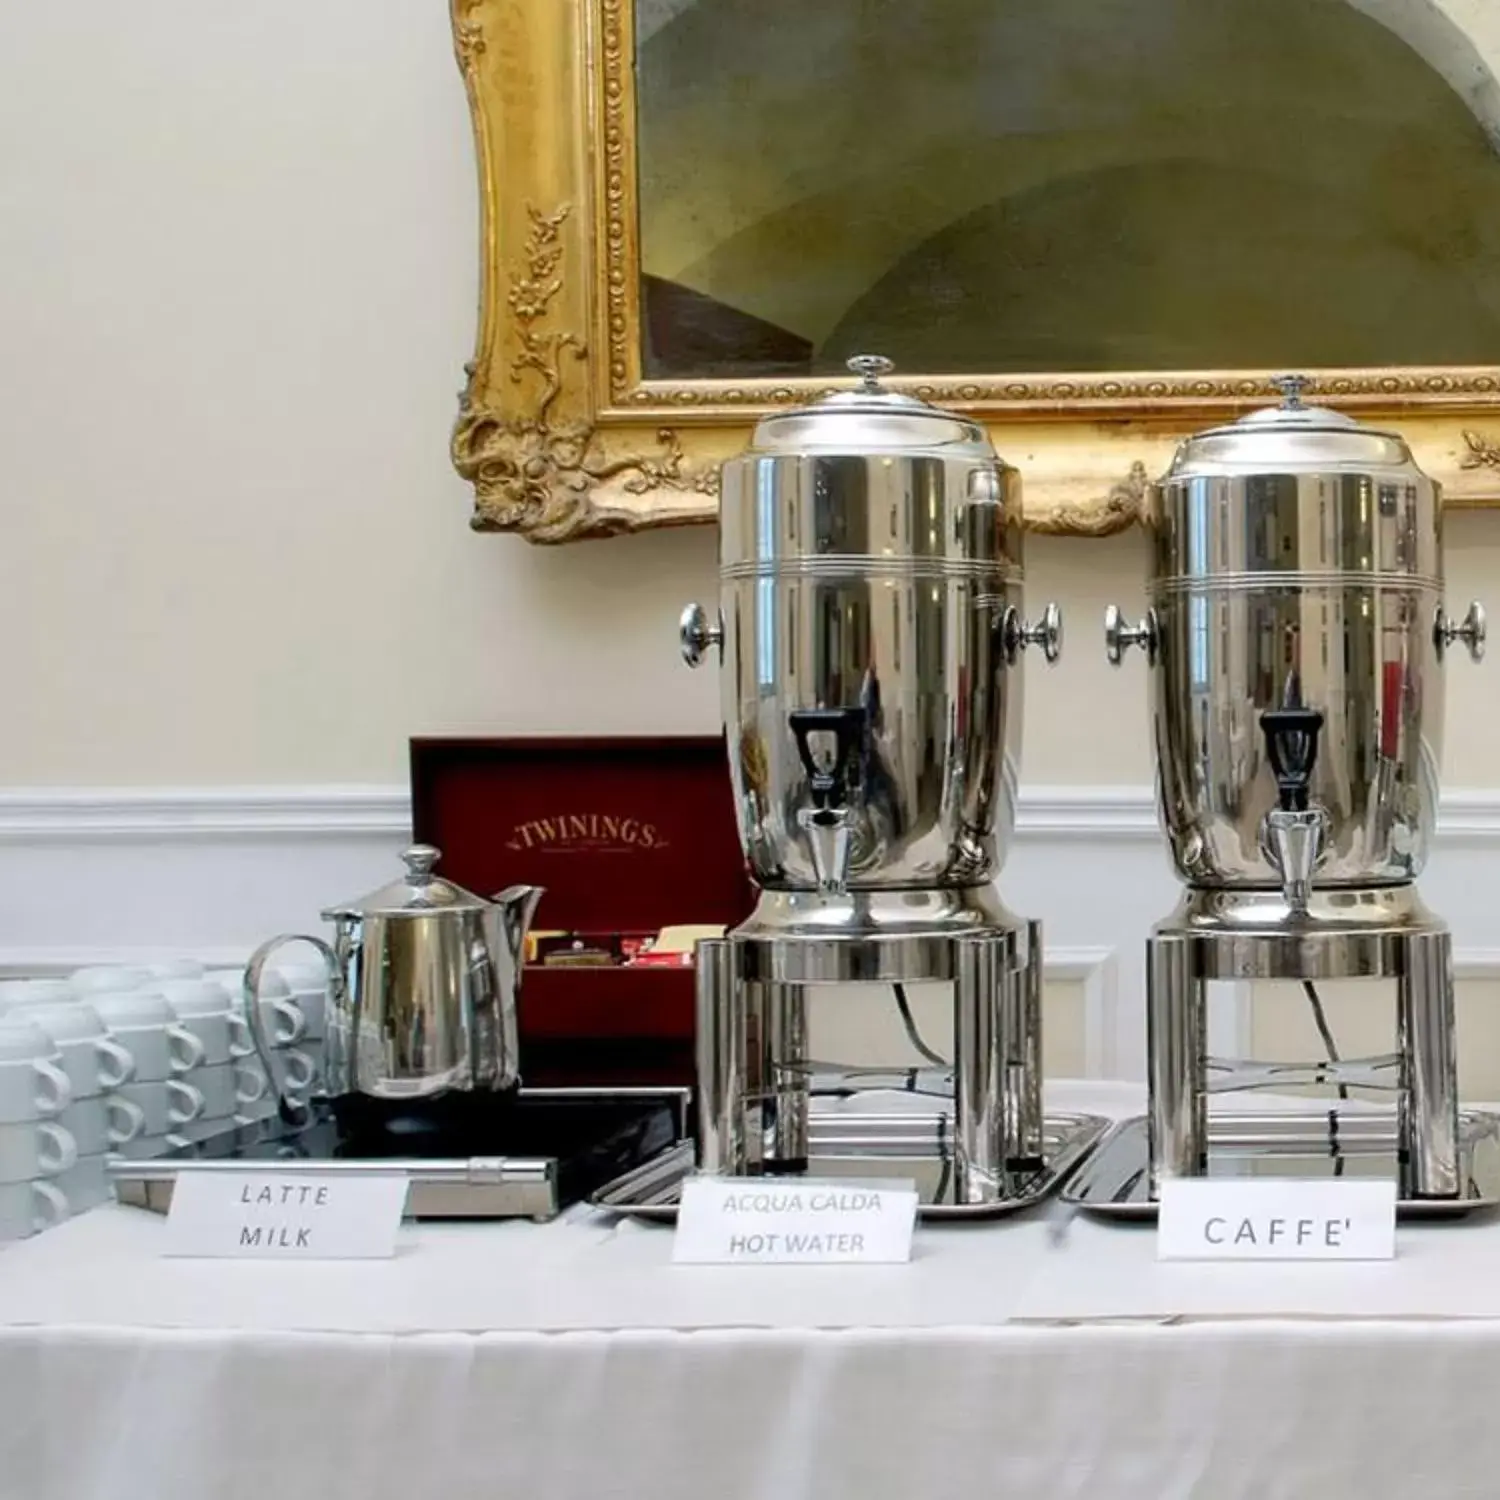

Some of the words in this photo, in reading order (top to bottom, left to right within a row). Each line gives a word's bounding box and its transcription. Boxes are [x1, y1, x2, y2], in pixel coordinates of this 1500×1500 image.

[514, 813, 657, 848] TWININGS
[239, 1184, 330, 1206] LATTE
[722, 1192, 802, 1213] ACQUA
[809, 1193, 882, 1212] CALDA
[238, 1226, 313, 1247] MILK
[1204, 1217, 1351, 1247] CAFFE'
[730, 1233, 780, 1254] HOT
[784, 1233, 865, 1253] WATER
